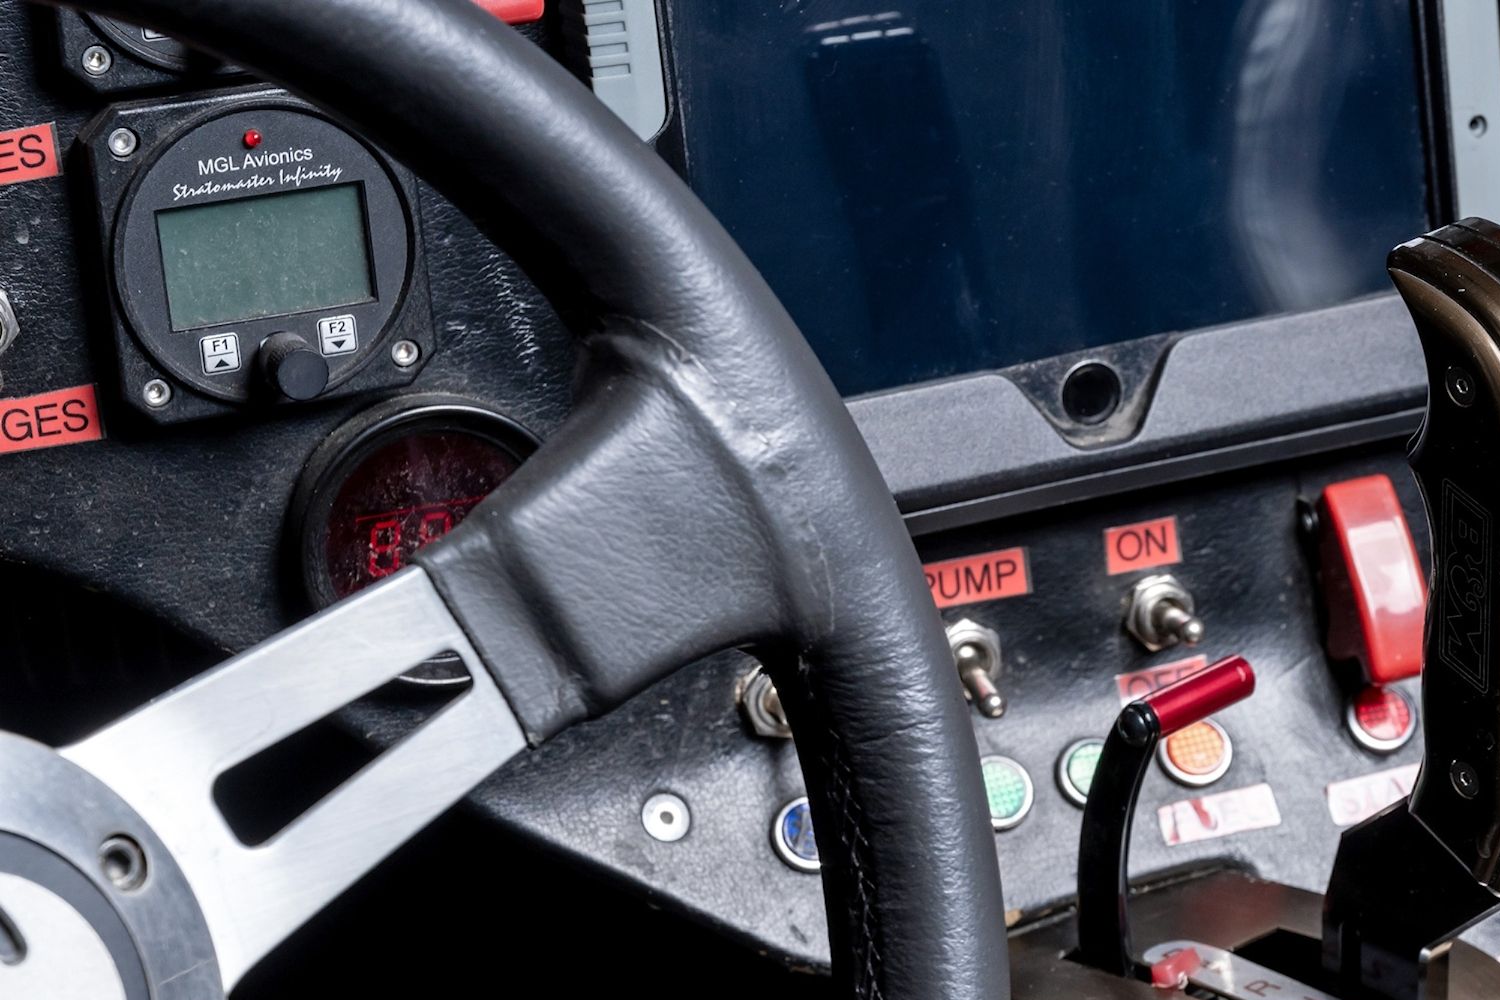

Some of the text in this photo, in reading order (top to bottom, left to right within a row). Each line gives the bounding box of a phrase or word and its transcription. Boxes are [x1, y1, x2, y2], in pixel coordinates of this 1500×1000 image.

[198, 147, 314, 176] MGL Avionics
[172, 164, 343, 201] Stratomaster Infinity
[329, 321, 346, 335] F2
[212, 339, 229, 353] F1
[1, 399, 89, 442] GES
[1116, 525, 1168, 563] ON
[1243, 980, 1282, 998] R
